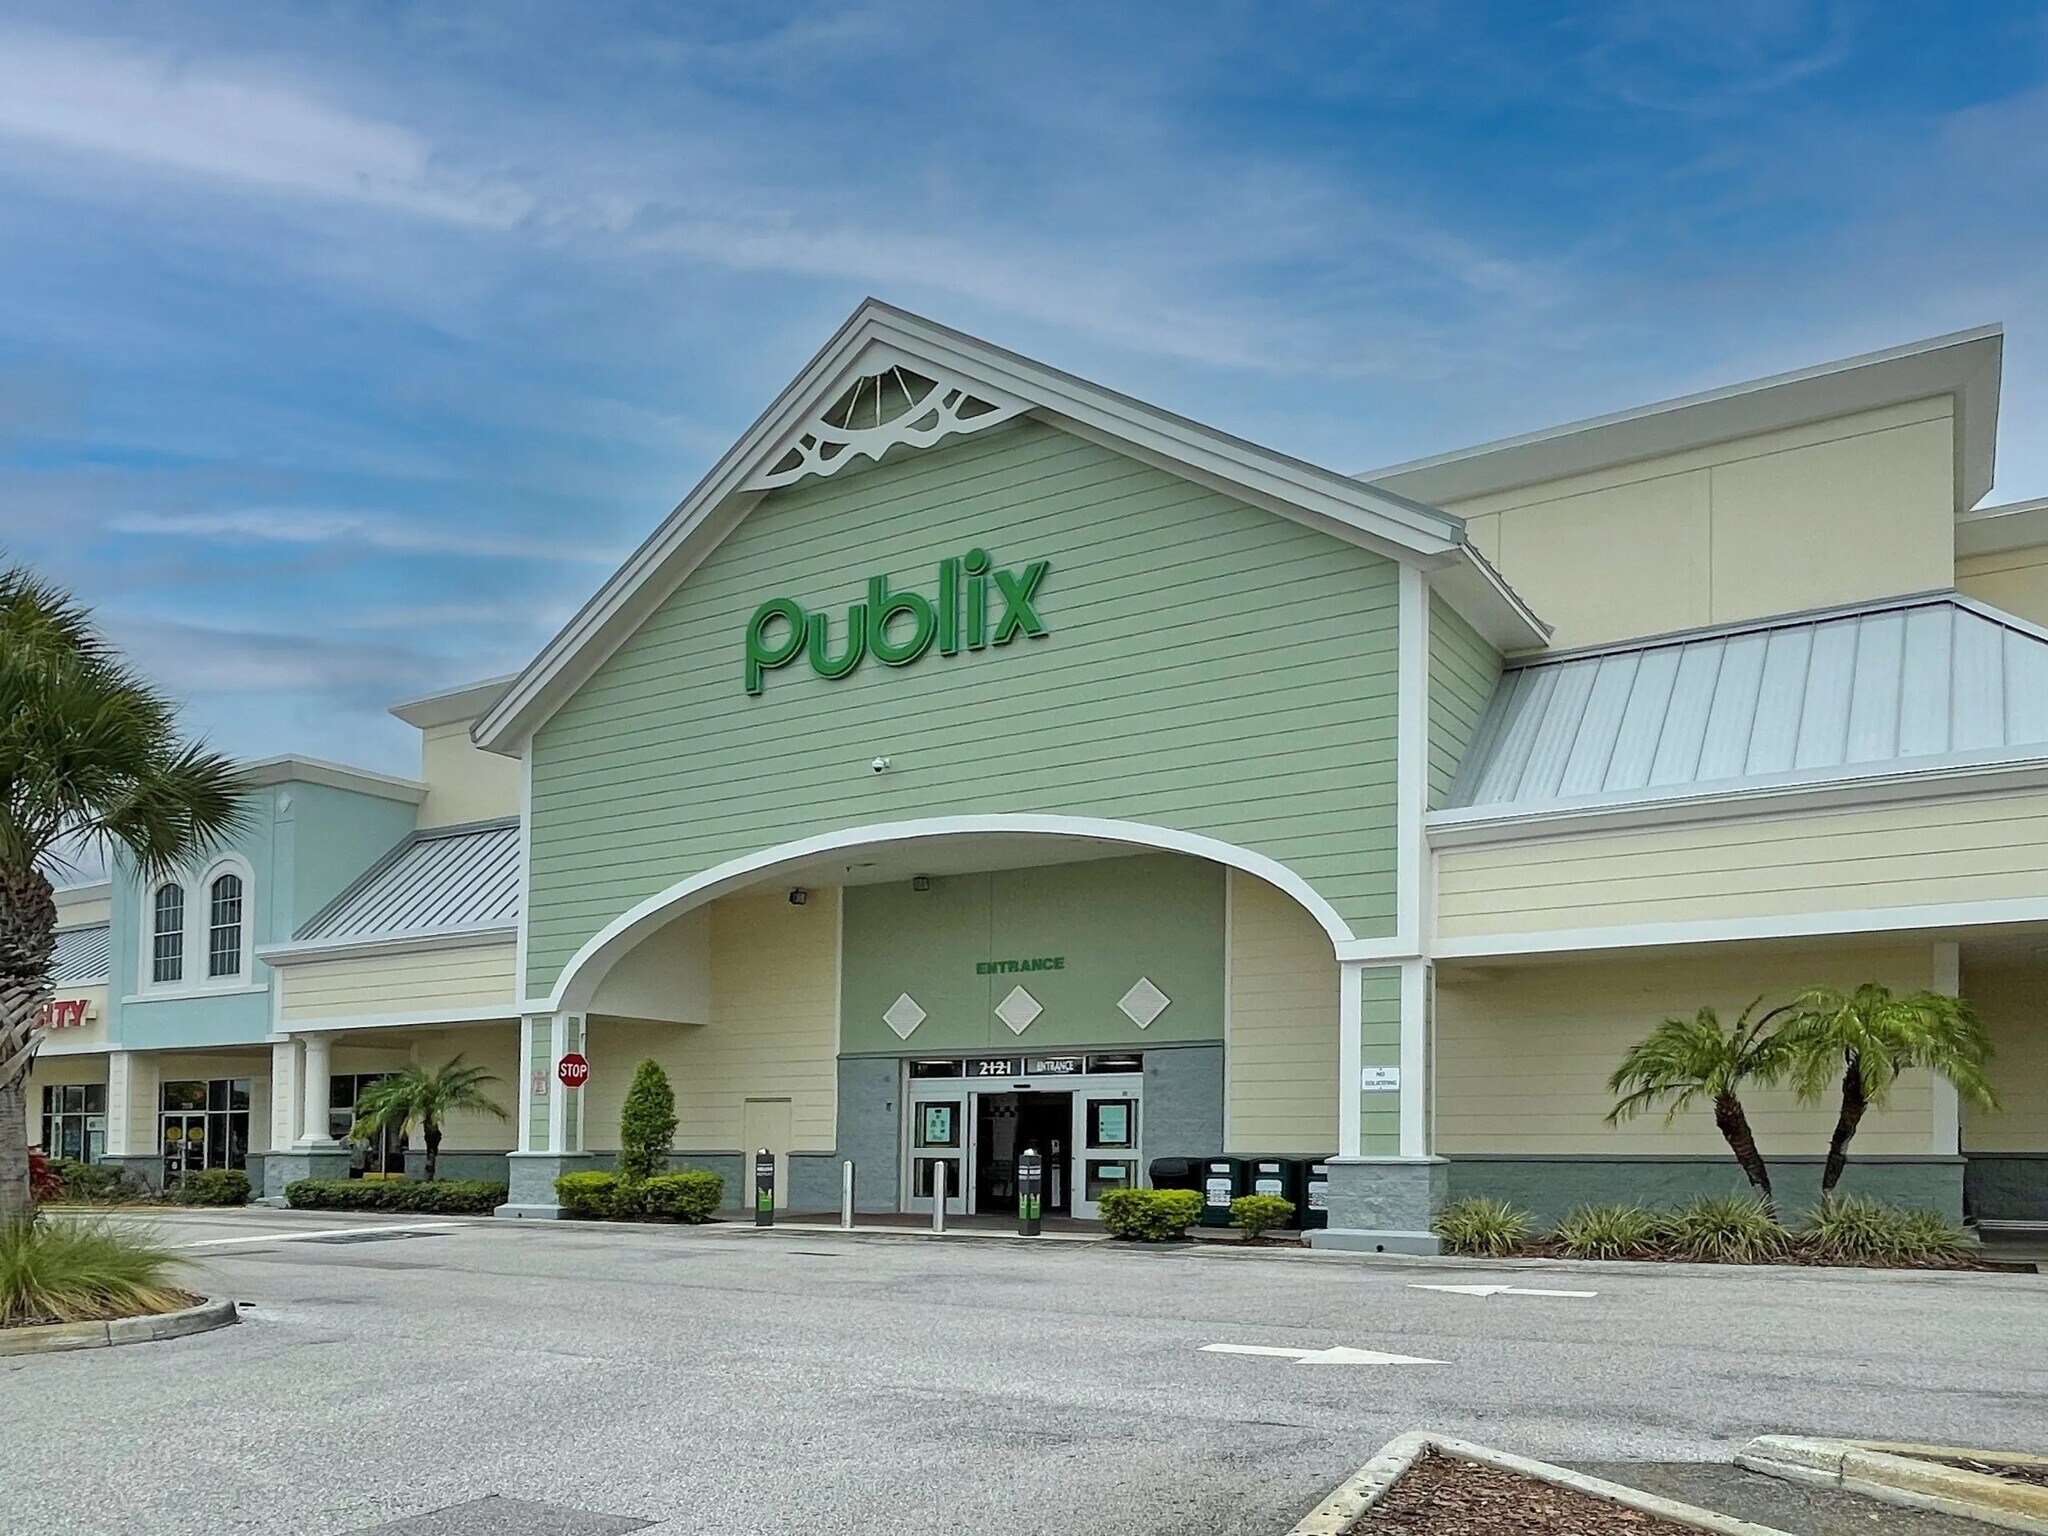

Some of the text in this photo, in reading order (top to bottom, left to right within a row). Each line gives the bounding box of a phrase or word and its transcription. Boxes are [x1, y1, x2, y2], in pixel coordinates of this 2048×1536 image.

[745, 547, 1050, 696] Publix
[976, 956, 1065, 975] ENTRANCE
[560, 1063, 588, 1078] STOP
[979, 1060, 1012, 1075] 2121
[1037, 1060, 1074, 1073] ENTRANCE
